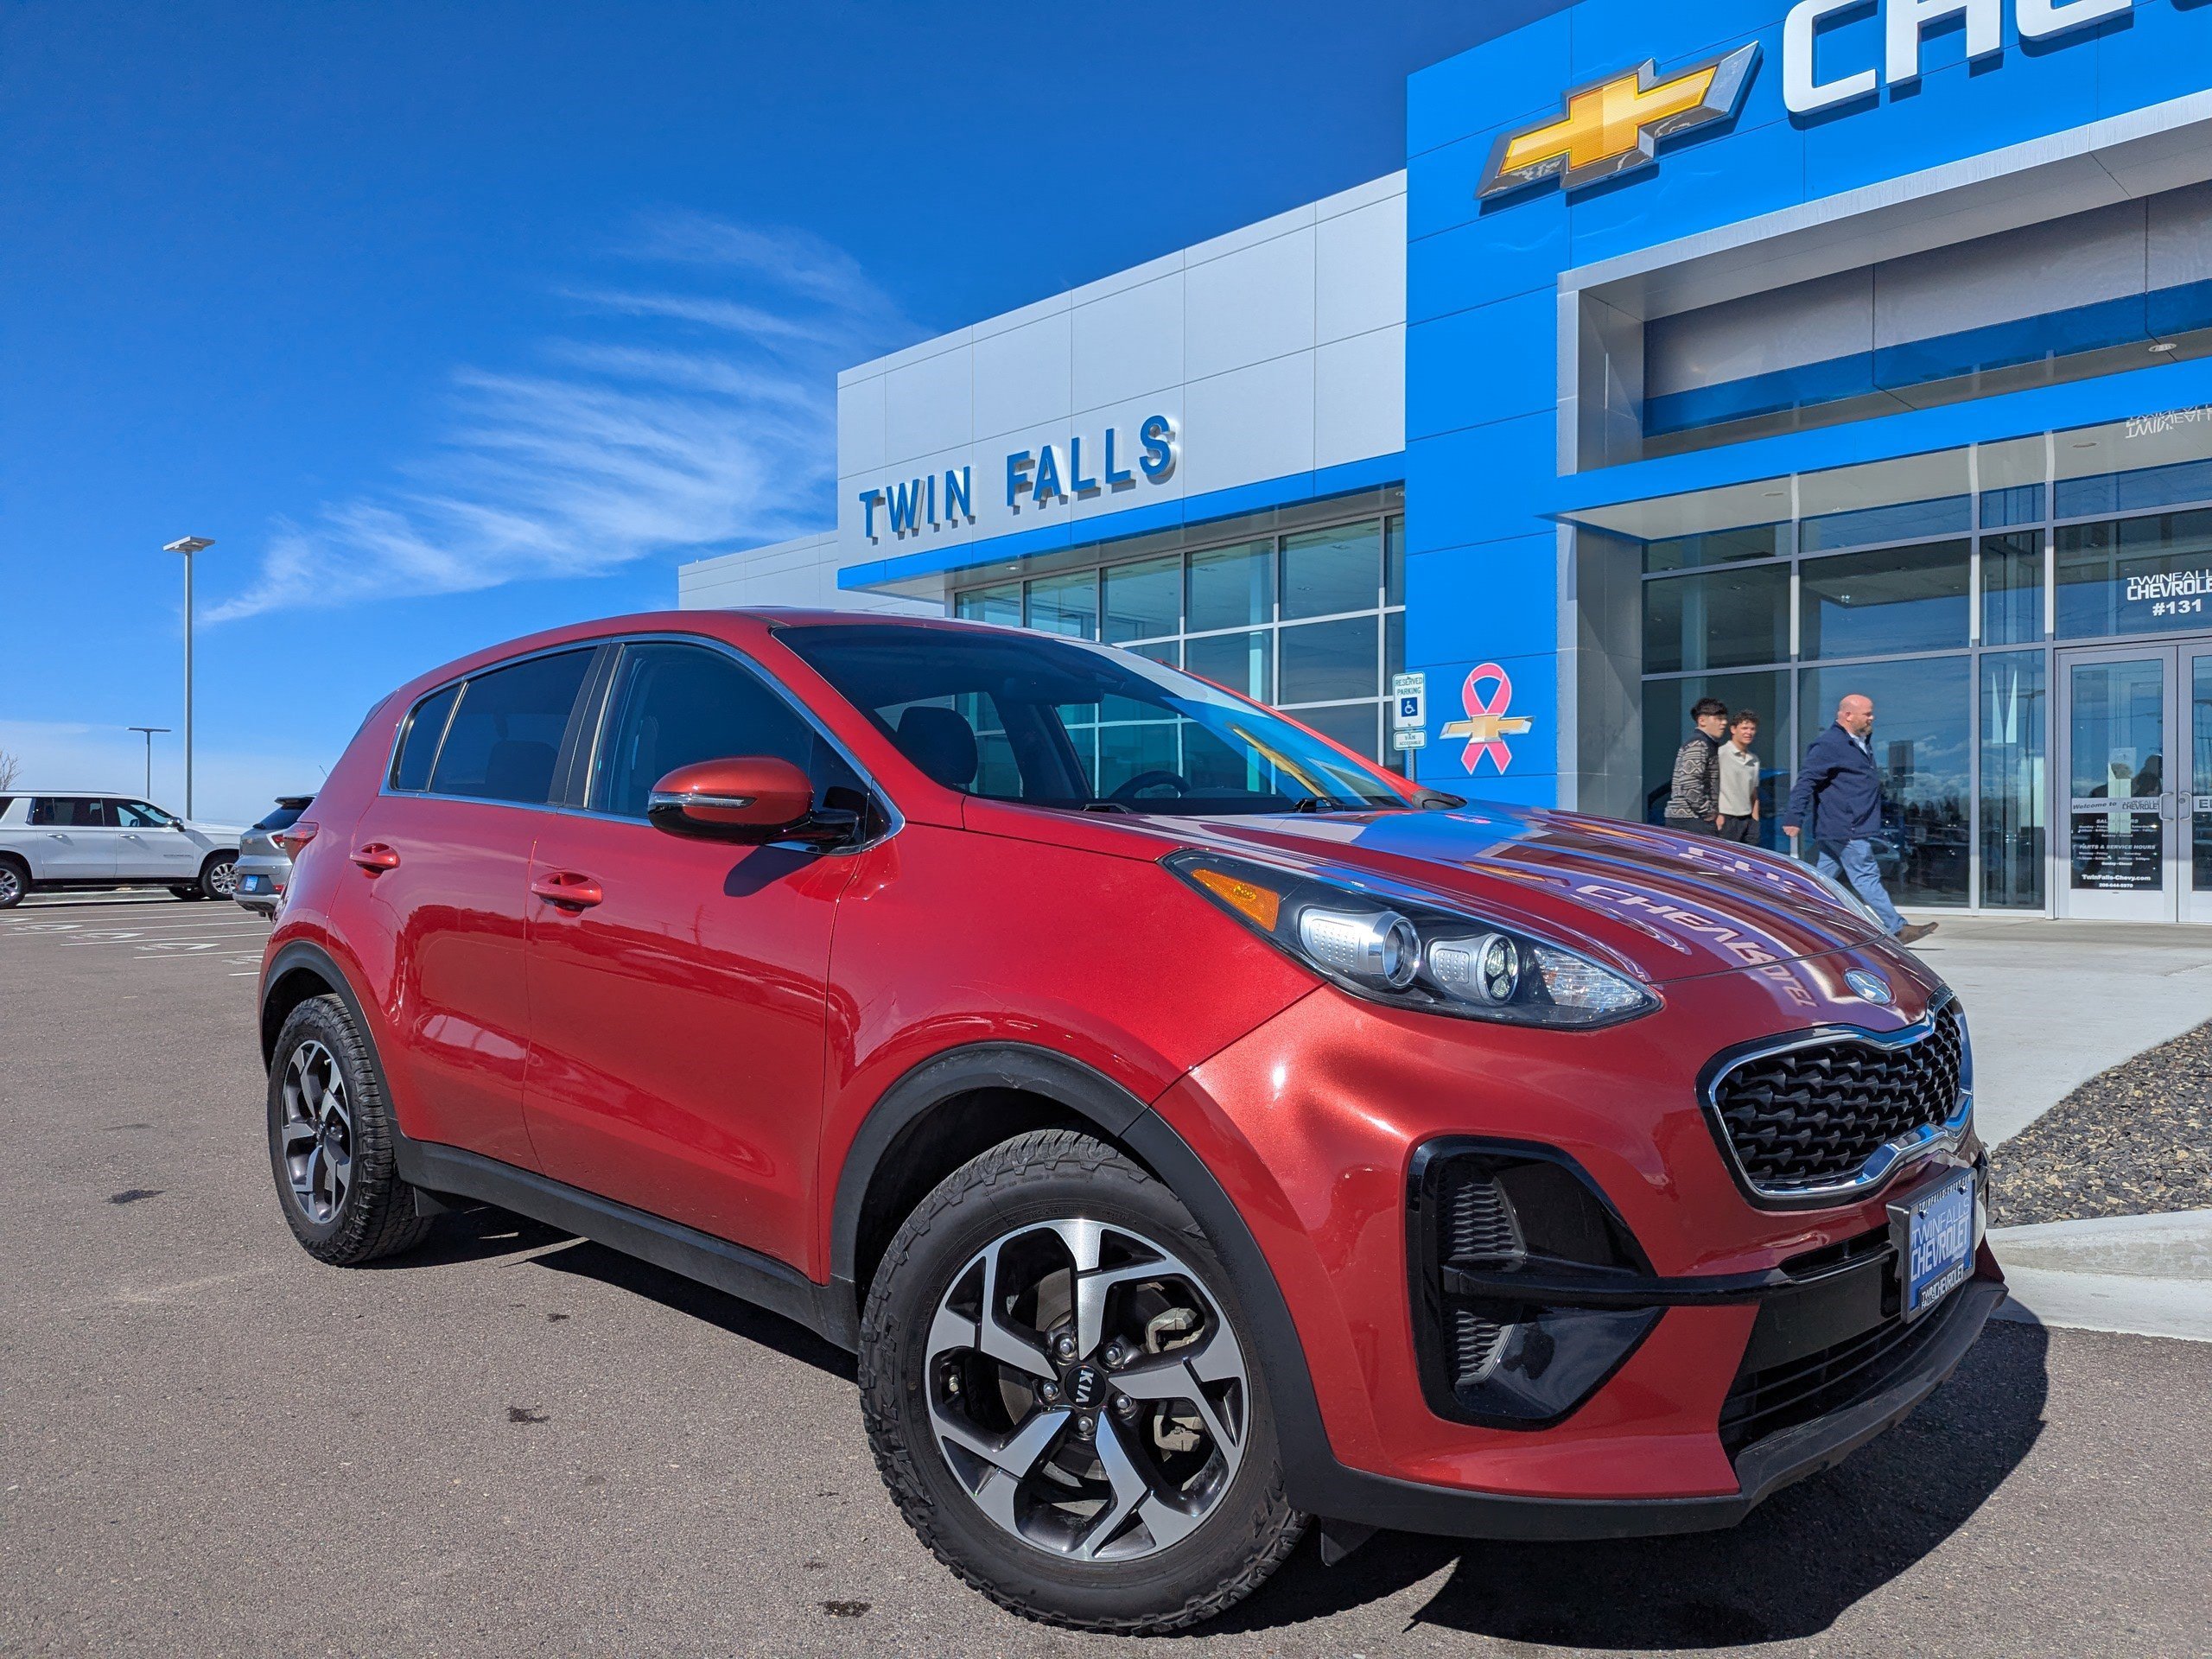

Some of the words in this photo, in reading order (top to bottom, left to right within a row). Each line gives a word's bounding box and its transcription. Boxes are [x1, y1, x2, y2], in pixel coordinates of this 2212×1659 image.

[859, 466, 971, 538] TWIN
[1007, 415, 1171, 507] FALLS
[2152, 599, 2202, 616] #131
[1395, 677, 1423, 686] RESERVED
[1396, 687, 1421, 696] PARKING
[1910, 1196, 1970, 1249] TWINFALLS
[1910, 1215, 1969, 1282] CHEVROLET
[1076, 1370, 1094, 1402] KIA
